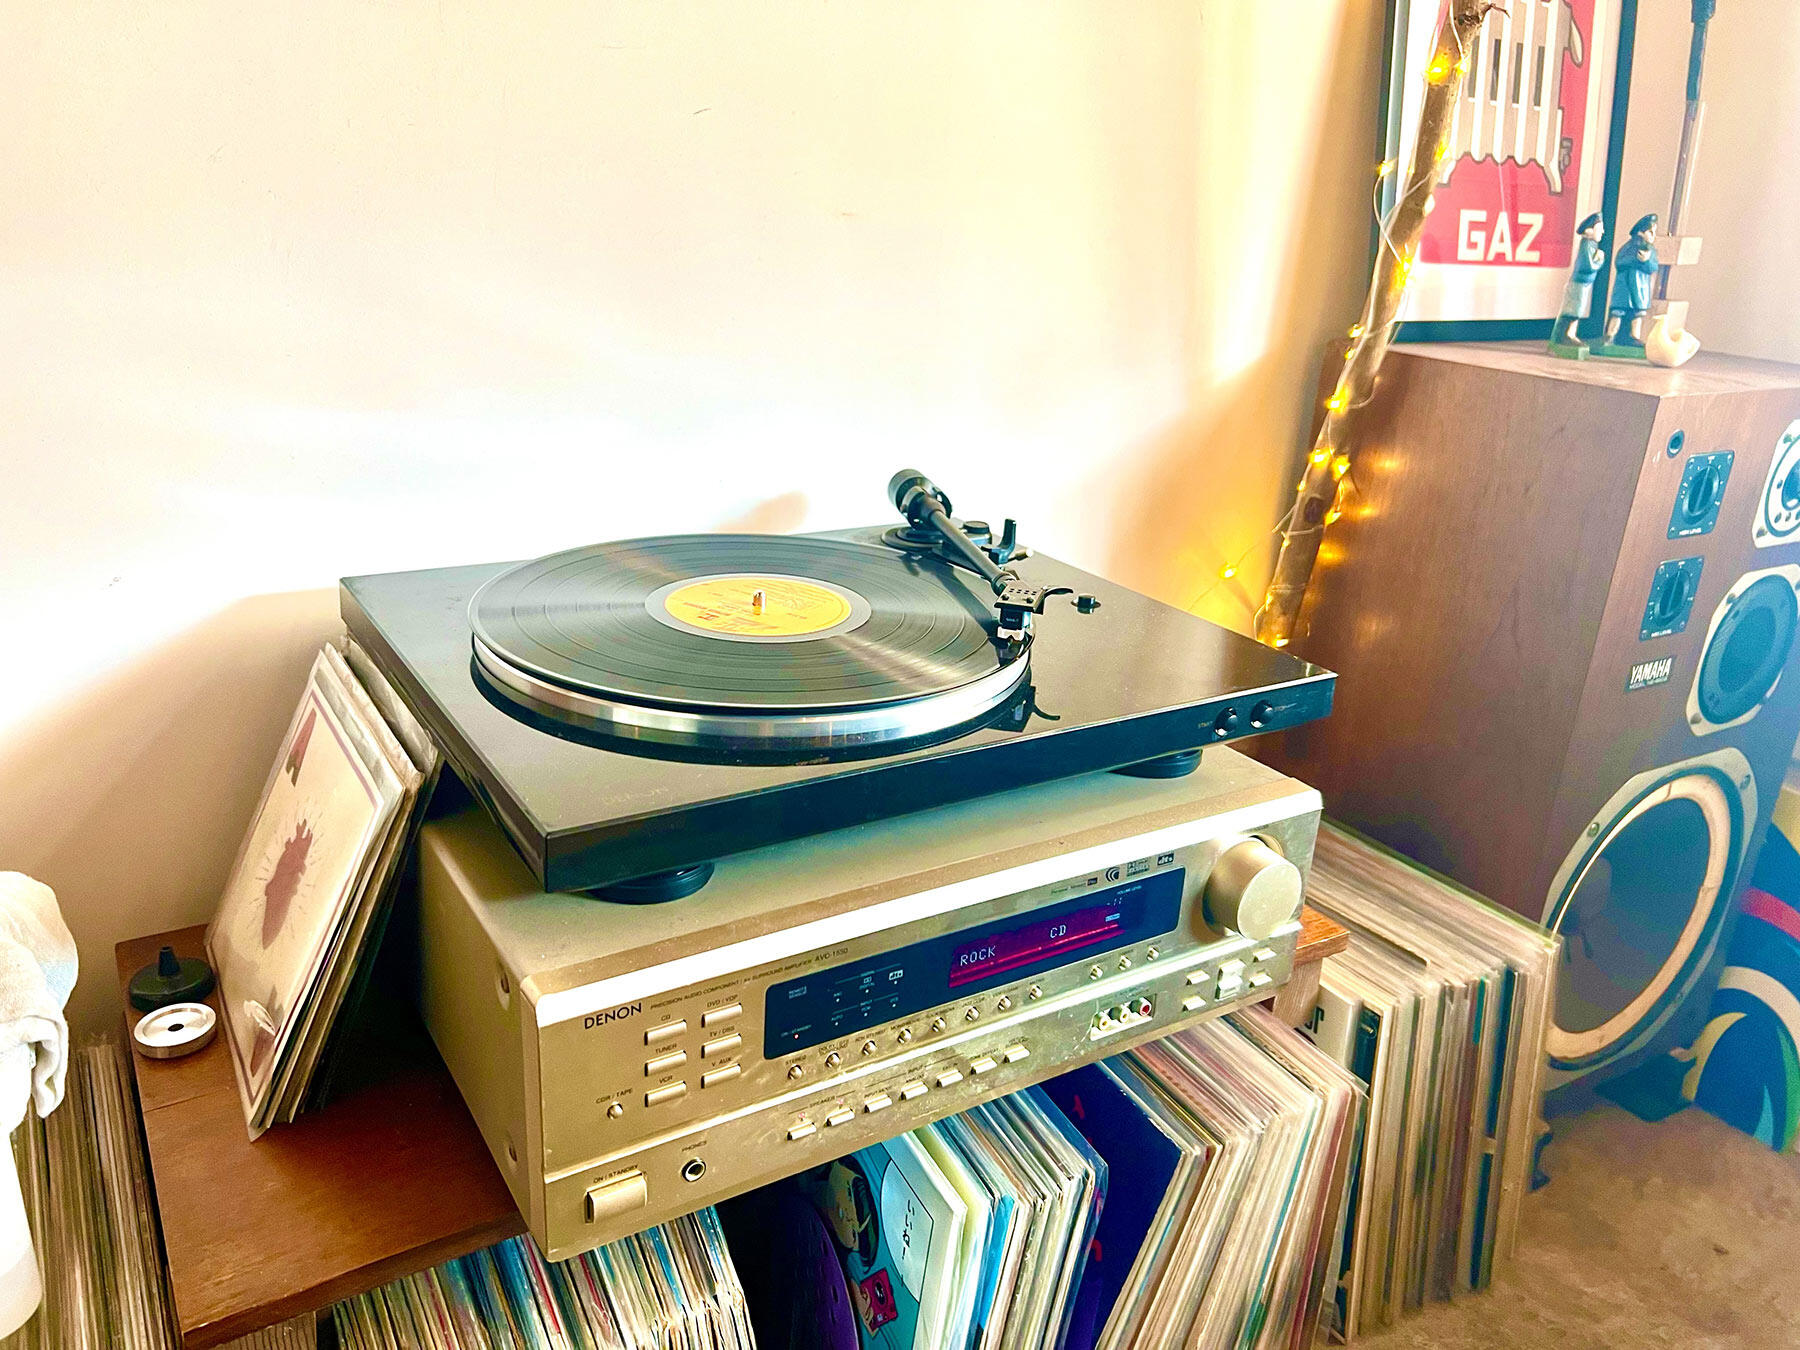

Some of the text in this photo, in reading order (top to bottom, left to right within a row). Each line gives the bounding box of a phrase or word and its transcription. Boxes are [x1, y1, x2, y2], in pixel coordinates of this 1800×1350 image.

[1456, 208, 1544, 263] GAZ
[1629, 657, 1673, 684] YAMAHA
[1050, 924, 1067, 939] CD
[959, 945, 996, 967] ROCK
[584, 1002, 643, 1030] DENON
